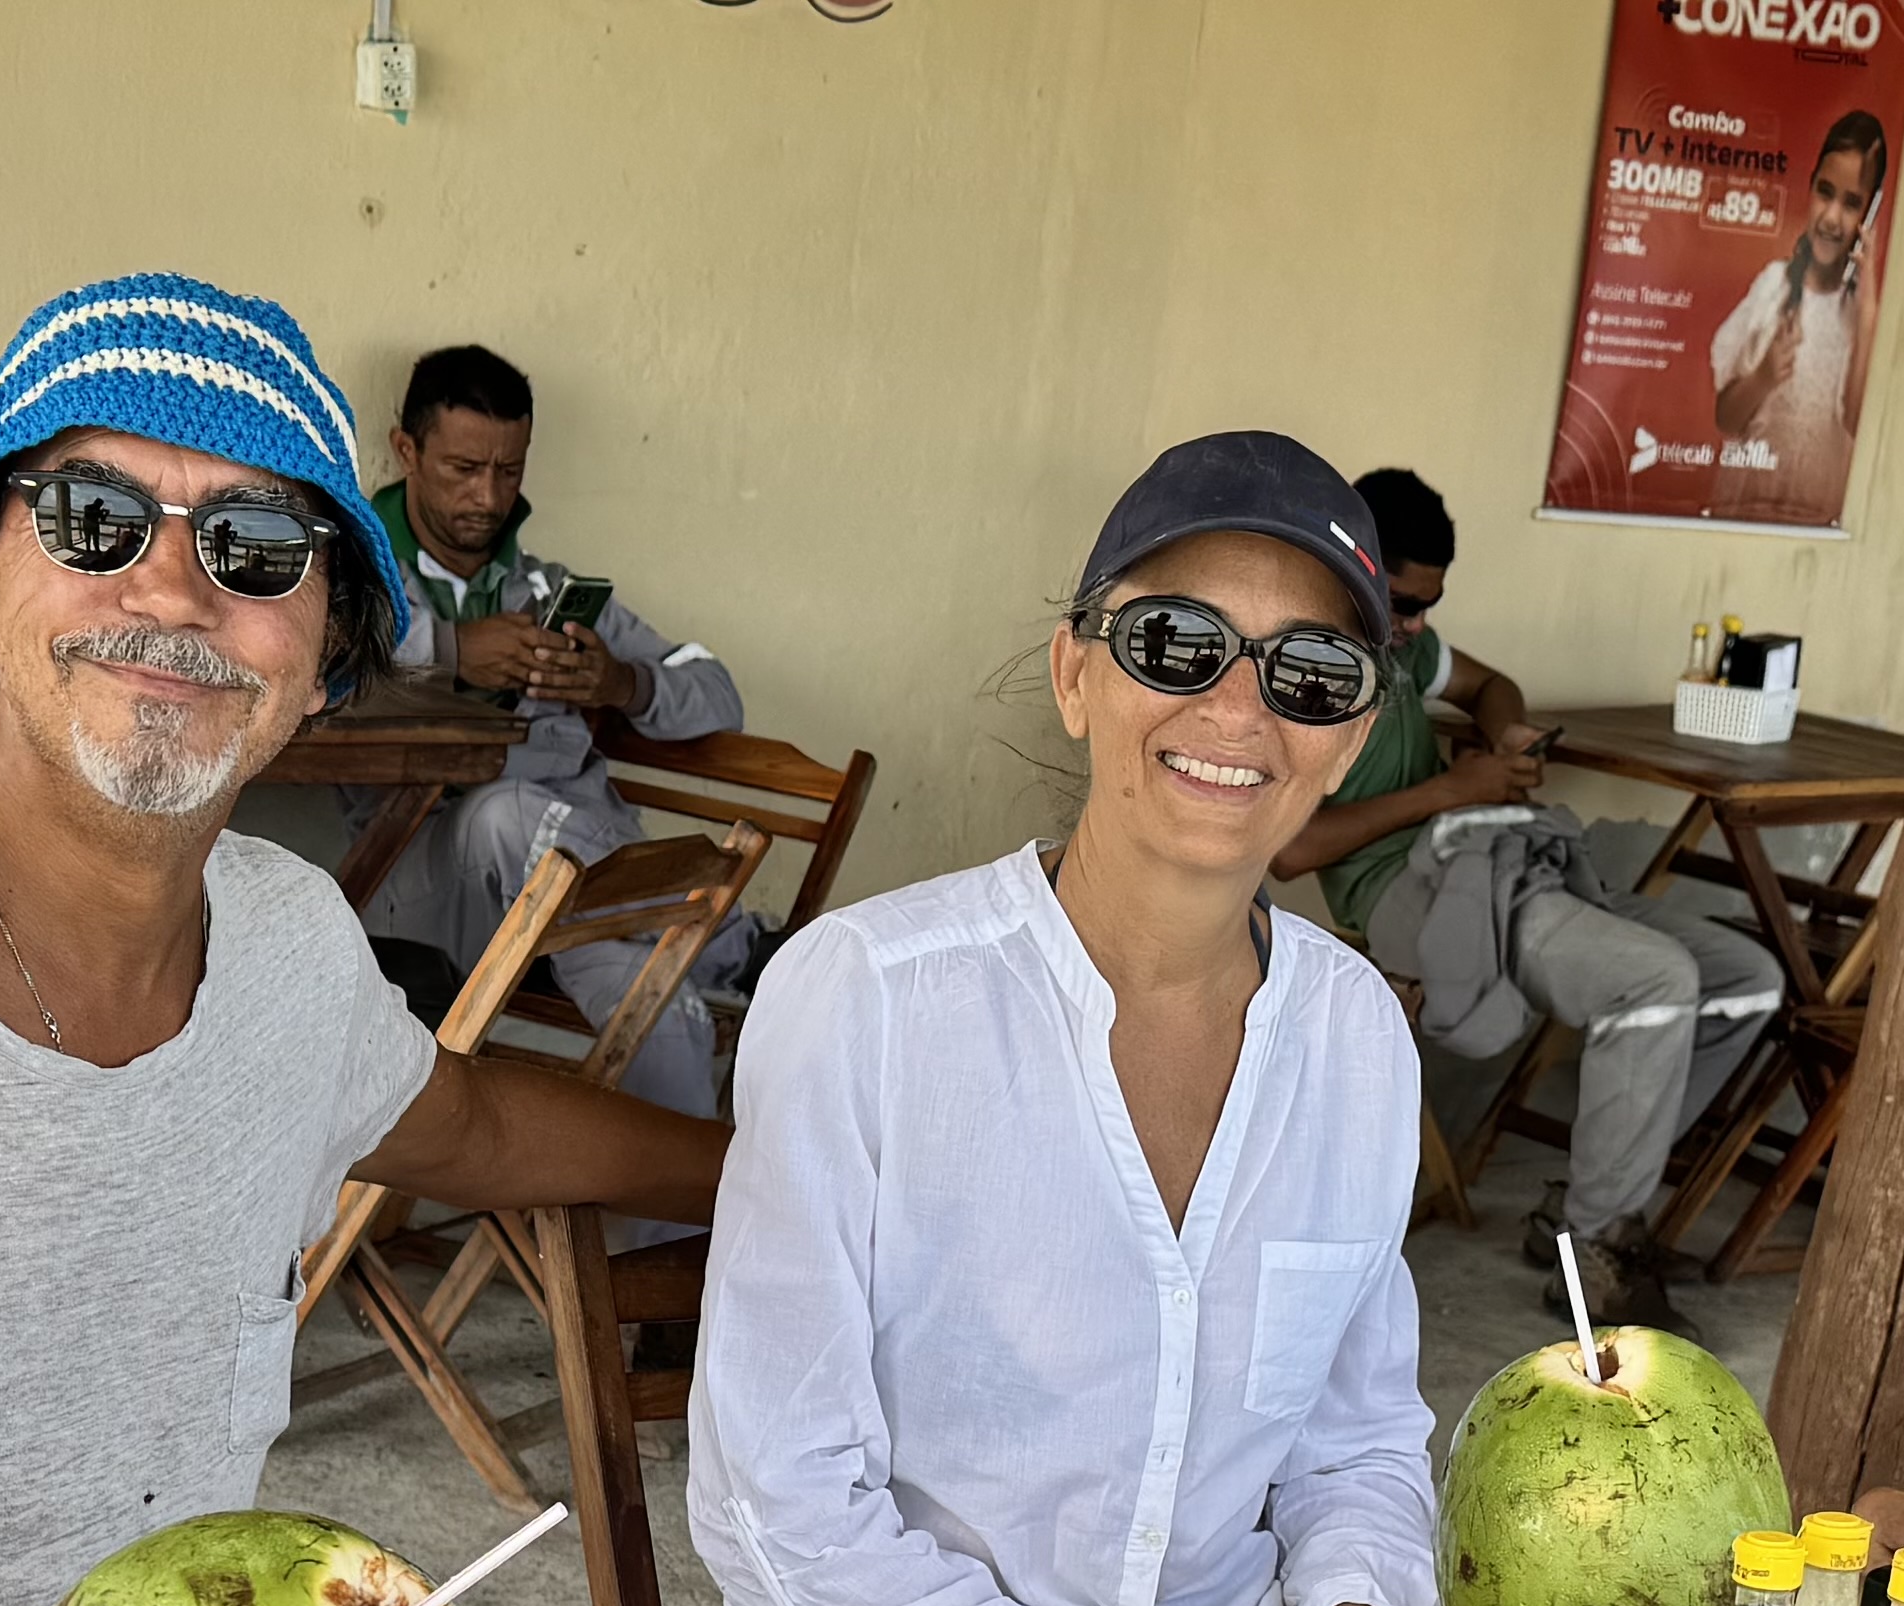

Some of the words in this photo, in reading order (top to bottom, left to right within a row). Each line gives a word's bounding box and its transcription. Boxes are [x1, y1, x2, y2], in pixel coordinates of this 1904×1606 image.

[1668, 104, 1746, 137] Combo
[1615, 127, 1655, 155] TV
[1661, 136, 1674, 156] +
[1681, 135, 1788, 173] Internet
[1607, 158, 1703, 198] 300MB
